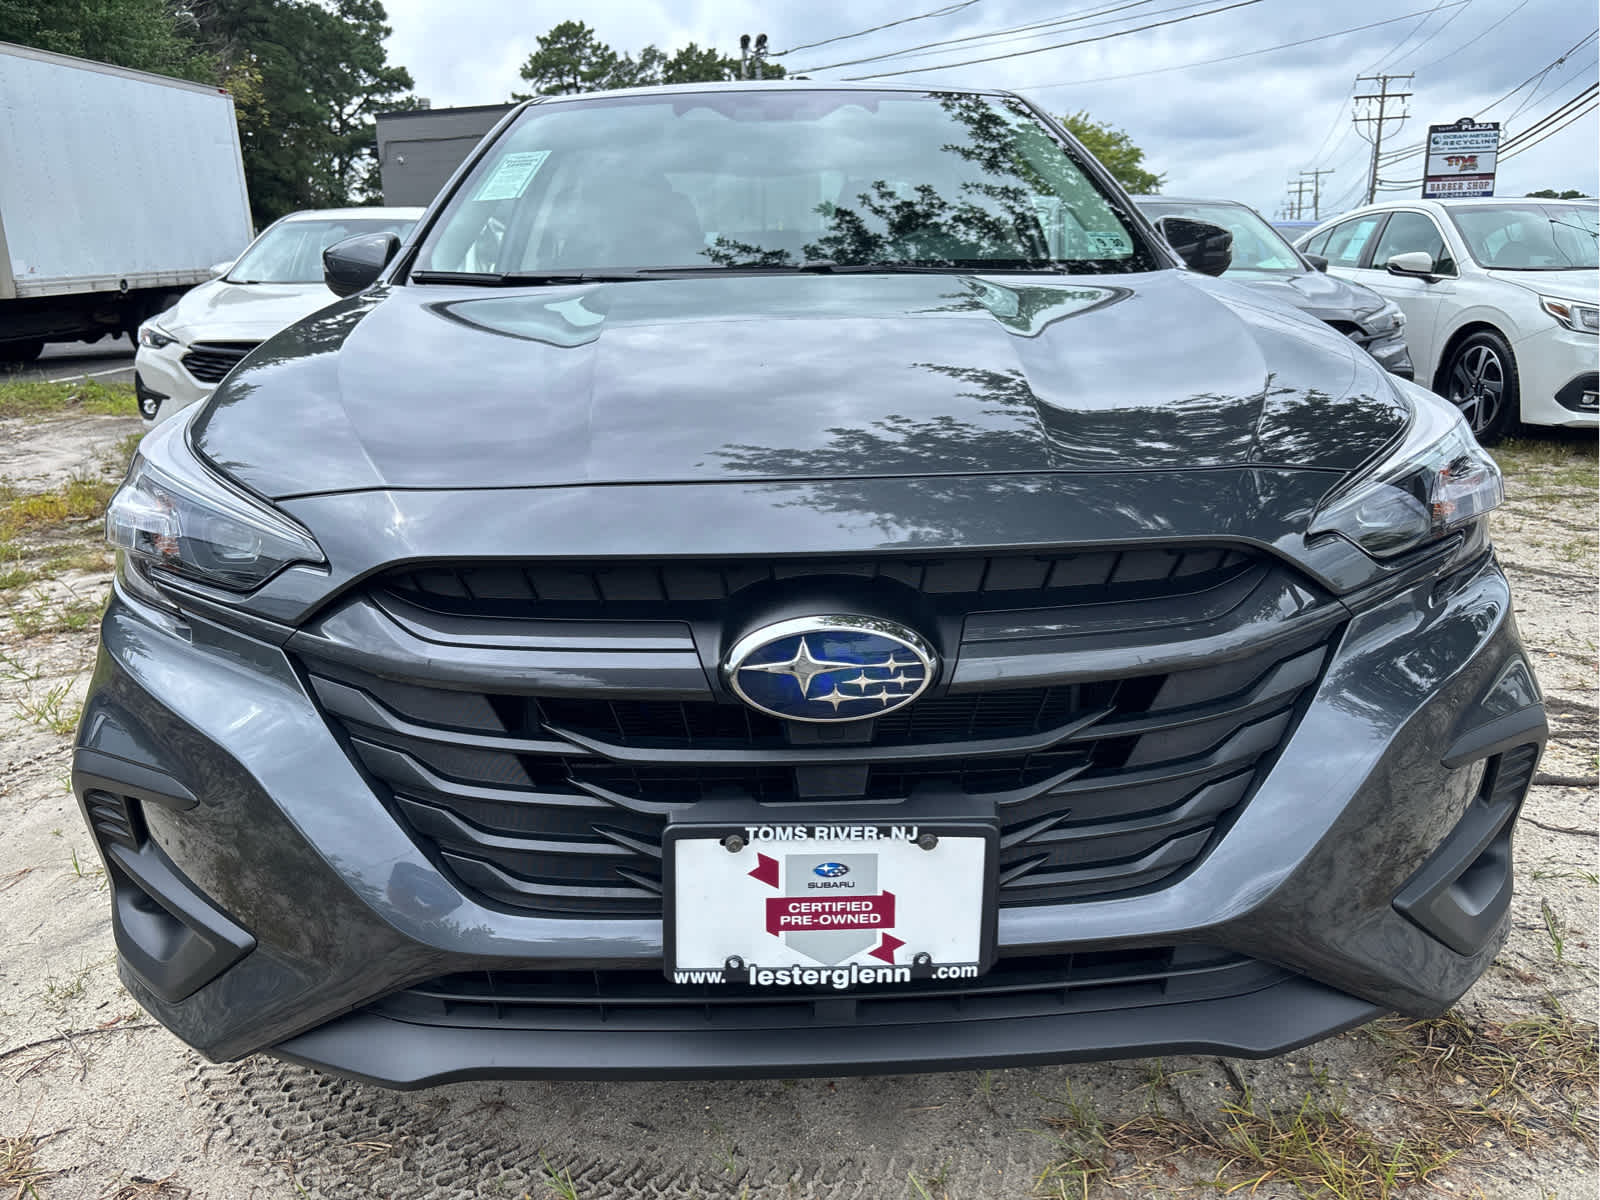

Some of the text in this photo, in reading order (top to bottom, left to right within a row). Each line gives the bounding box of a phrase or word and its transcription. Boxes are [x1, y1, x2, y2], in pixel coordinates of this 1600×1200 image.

[1462, 123, 1494, 131] PLAZA
[1430, 181, 1490, 192] BARBER SHOP
[745, 826, 808, 842] TOMS
[891, 826, 919, 841] NJ
[807, 881, 856, 889] SUBARU
[788, 901, 873, 914] CERTIFIED
[780, 913, 881, 926] PRE-OWNED
[674, 964, 978, 989] www. lesterglenn .com
